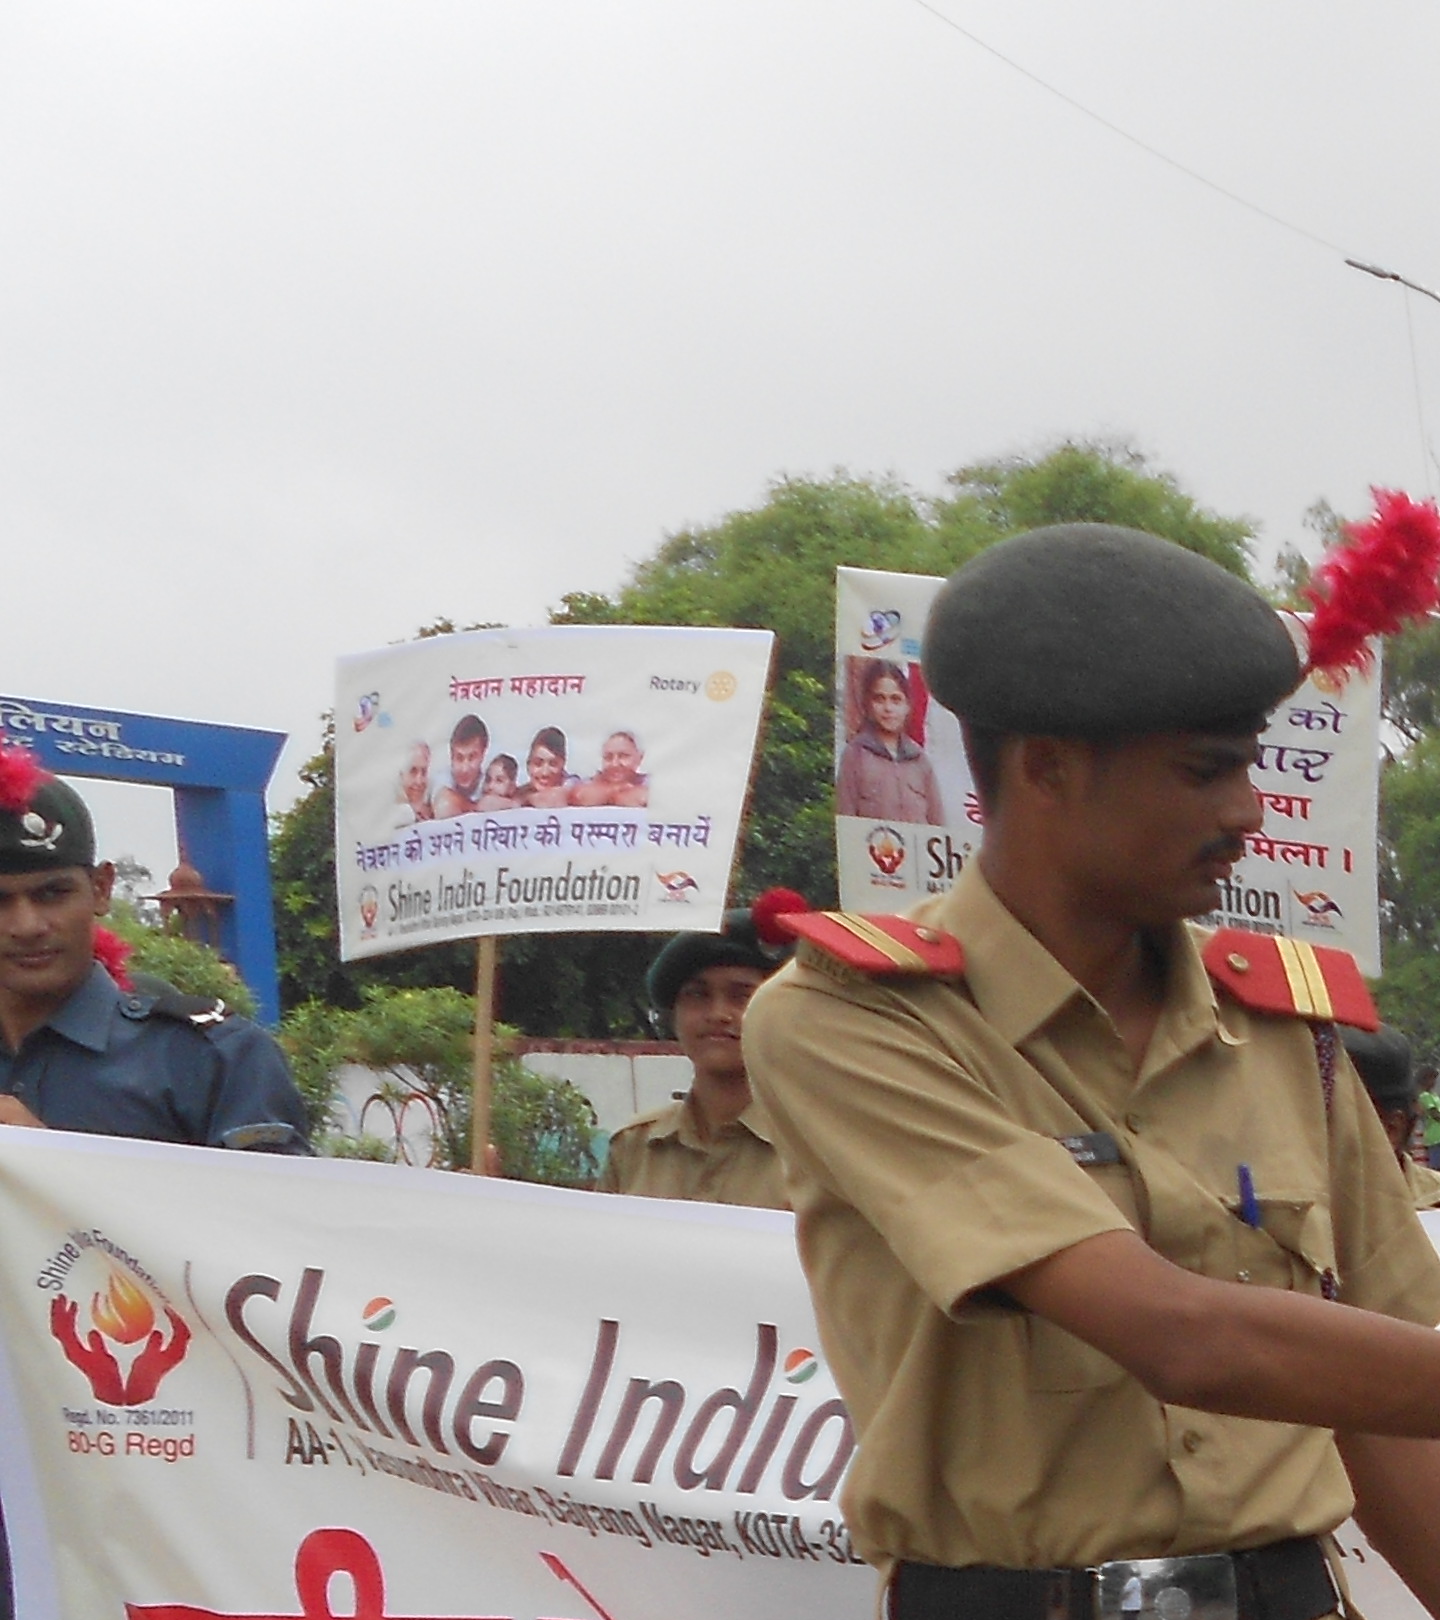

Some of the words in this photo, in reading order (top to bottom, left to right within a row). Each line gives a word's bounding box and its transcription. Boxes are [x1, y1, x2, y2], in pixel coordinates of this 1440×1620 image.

[449, 675, 503, 702] नेत्रदान
[510, 675, 586, 697] महादान
[649, 676, 701, 693] Rotary
[1289, 701, 1349, 734] को
[388, 879, 431, 922] Shine
[438, 868, 486, 911] India
[495, 861, 641, 907] Foundation
[37, 1242, 81, 1291] Shine
[224, 1266, 525, 1466] Shine
[557, 1318, 857, 1502] India
[97, 1409, 120, 1425] No.
[125, 1409, 194, 1425] 7361/2011
[68, 1430, 116, 1456] 80-G
[126, 1432, 195, 1462] Regd
[532, 1485, 653, 1549] Bajrang
[638, 1500, 743, 1560] Nagar,
[734, 1510, 868, 1566] KOTA-32
